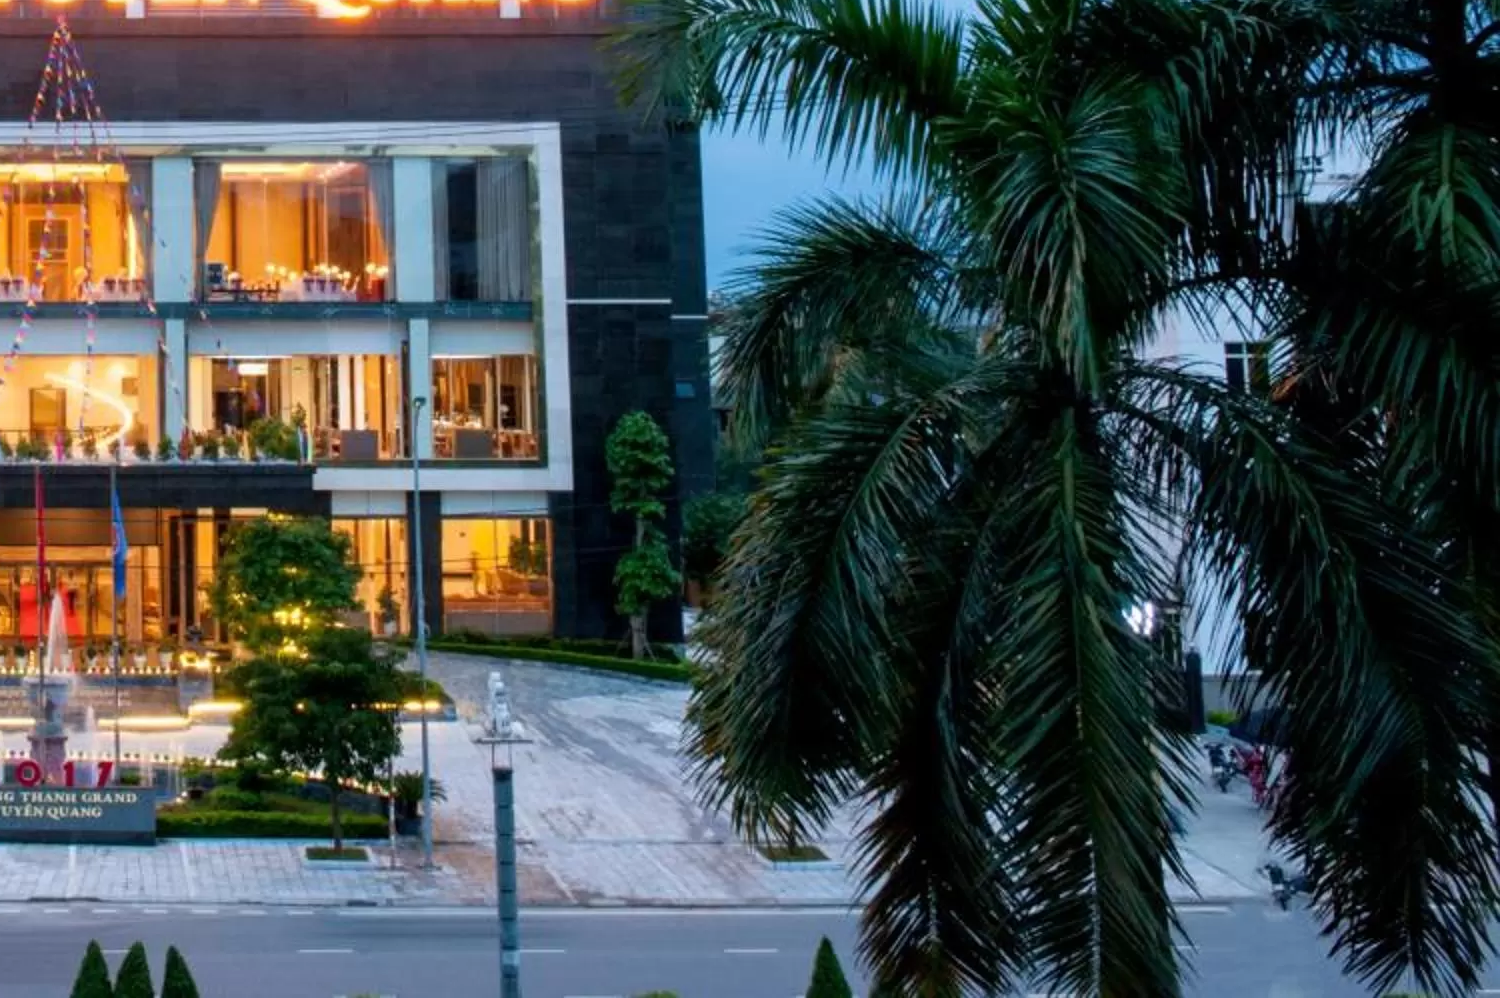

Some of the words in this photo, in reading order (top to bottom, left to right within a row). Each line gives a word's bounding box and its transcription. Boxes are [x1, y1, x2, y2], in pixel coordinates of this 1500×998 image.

[20, 790, 77, 803] THANH
[81, 791, 138, 803] GRAND
[47, 805, 103, 821] QUANG
